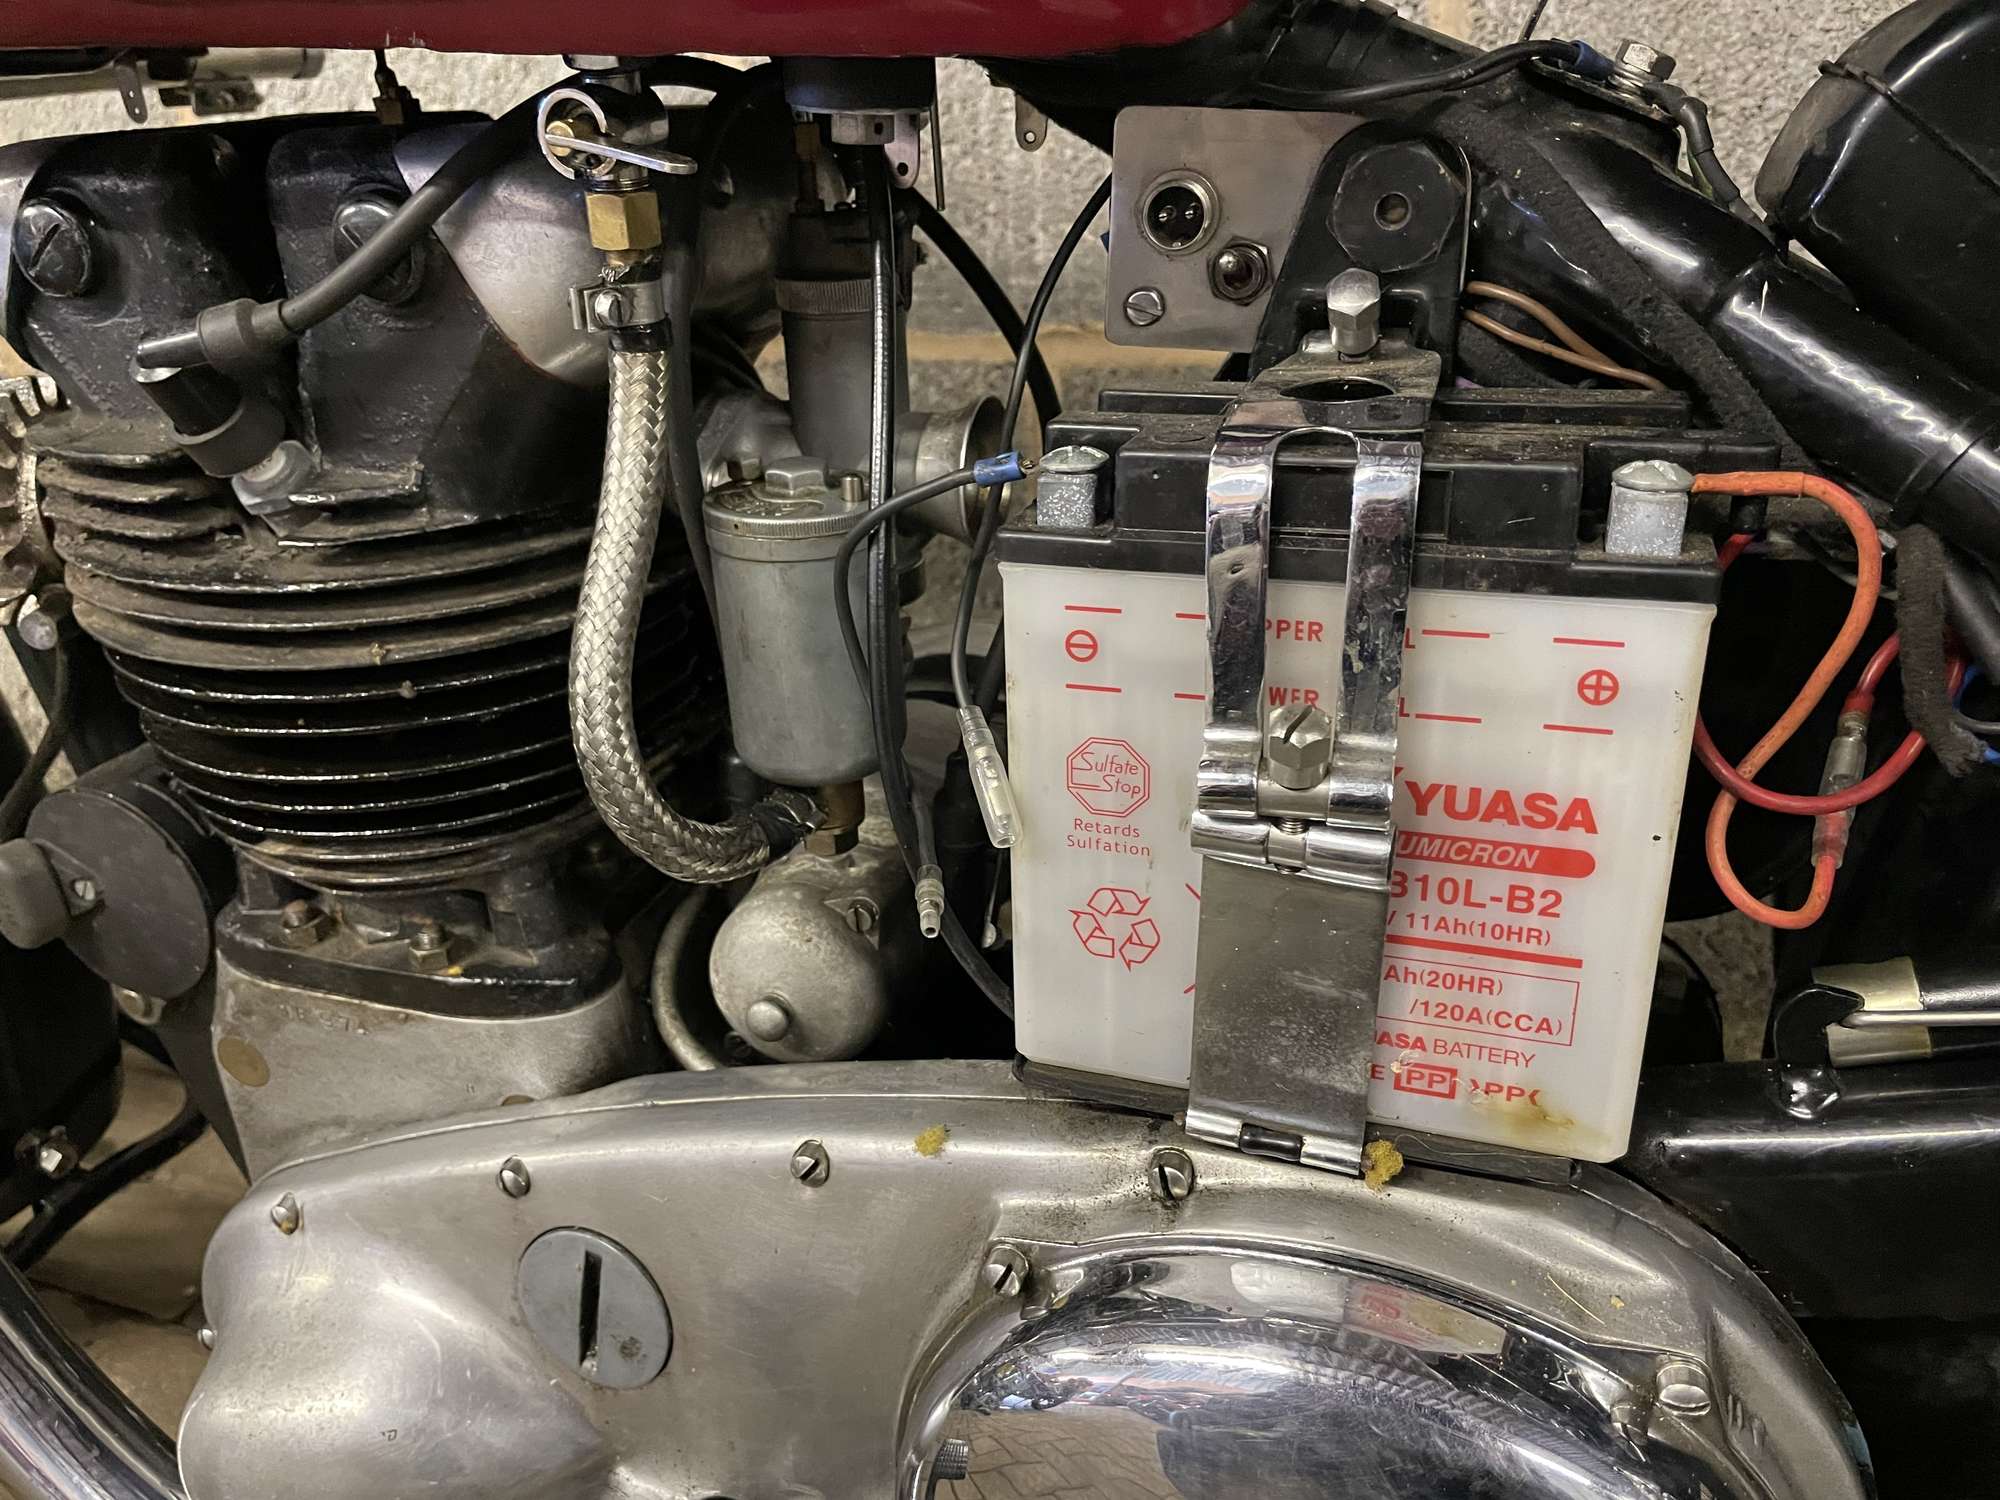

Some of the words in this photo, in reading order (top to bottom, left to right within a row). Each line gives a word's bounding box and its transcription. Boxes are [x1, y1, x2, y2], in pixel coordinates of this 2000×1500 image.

[1072, 751, 1139, 776] Sulfate
[1100, 774, 1141, 799] Stop
[1404, 780, 1599, 835] YUASA
[1074, 818, 1140, 838] Retards
[1066, 834, 1150, 857] Sulfation
[1406, 912, 1552, 946] 11Ah(10HR)
[1383, 964, 1504, 996] Ah(20HR)
[1409, 998, 1563, 1037] /120A(CCA)
[1433, 1038, 1537, 1068] BATTERY
[1405, 1069, 1448, 1089] PP
